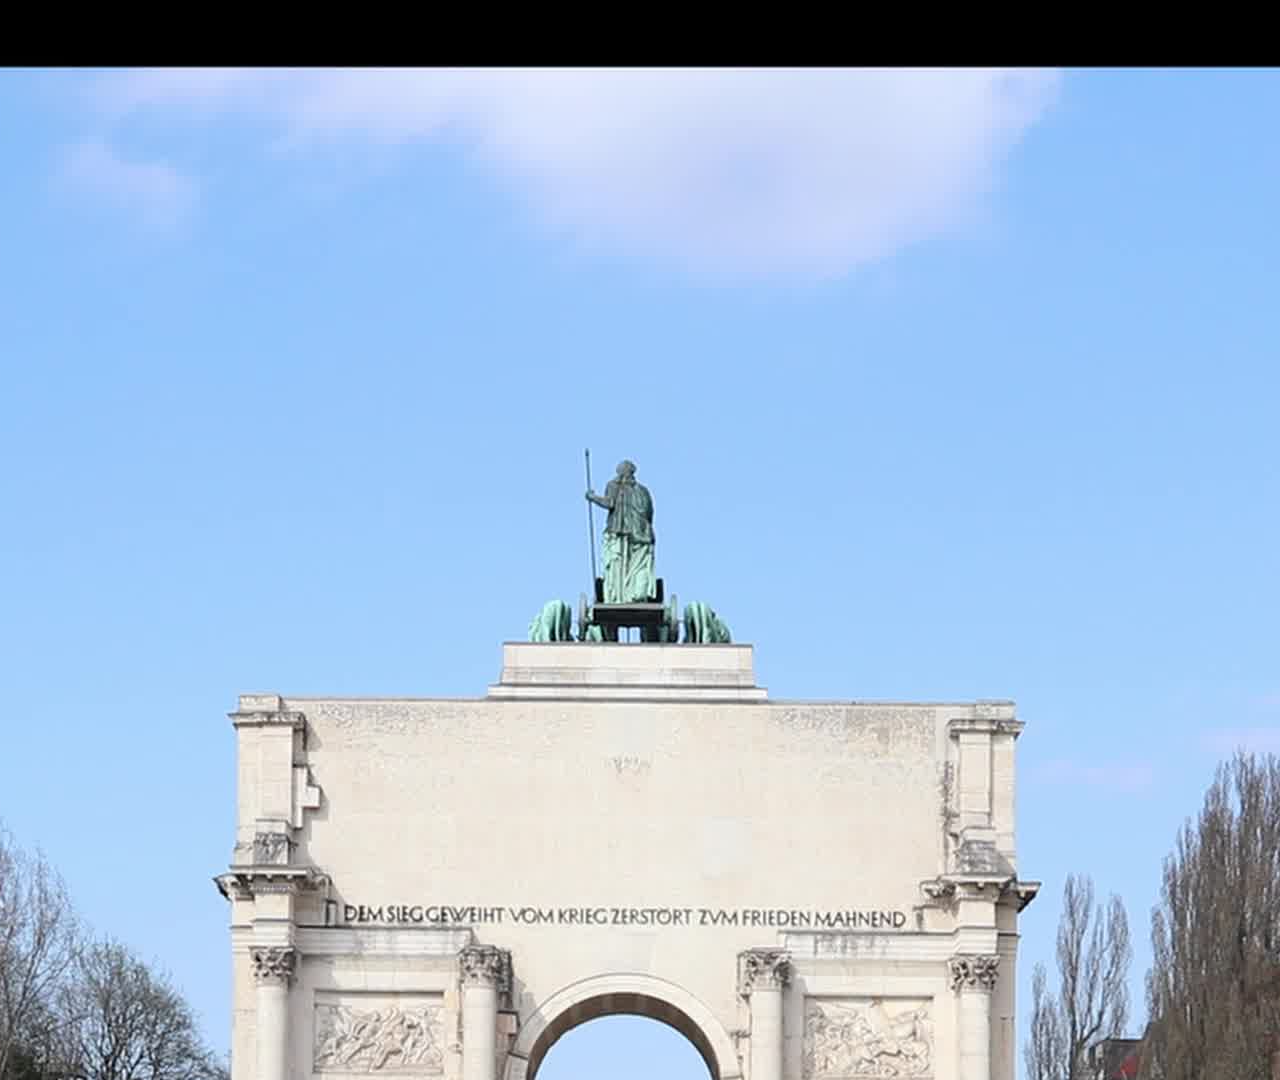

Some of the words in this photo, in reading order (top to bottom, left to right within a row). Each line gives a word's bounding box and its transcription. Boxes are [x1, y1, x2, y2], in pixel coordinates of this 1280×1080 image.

[344, 904, 383, 923] DEM
[388, 904, 424, 923] SIEG
[424, 905, 506, 924] GEWEIHT
[509, 907, 555, 924] VOM
[557, 907, 607, 925] KRIEG
[698, 909, 738, 926] ZVM
[741, 910, 811, 927] FRIEDEN
[814, 910, 907, 929] MAHNEND
